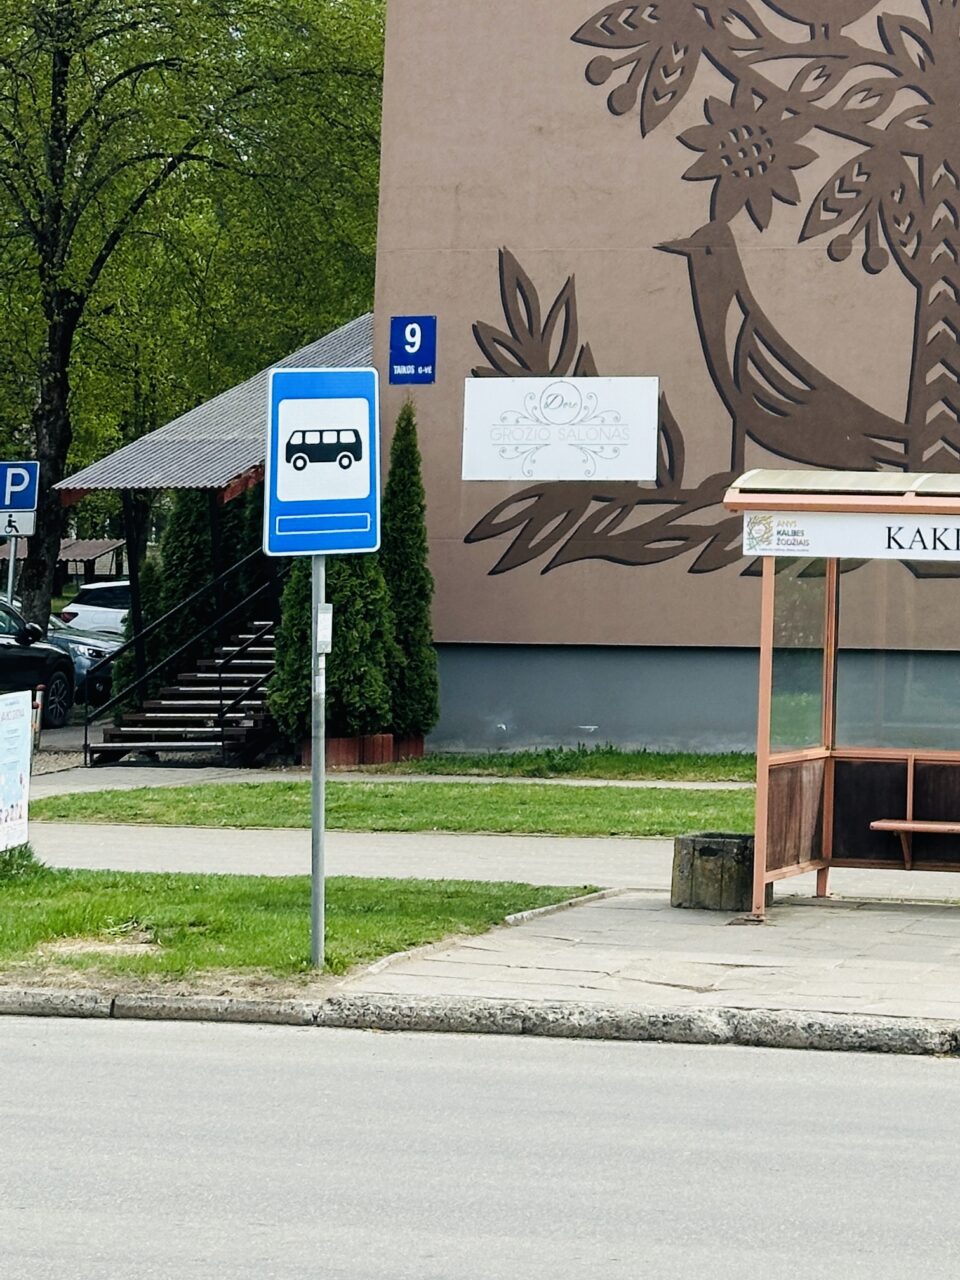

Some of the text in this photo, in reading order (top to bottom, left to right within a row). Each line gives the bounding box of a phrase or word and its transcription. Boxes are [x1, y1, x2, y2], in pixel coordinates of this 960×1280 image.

[404, 322, 422, 354] 9
[558, 427, 630, 441] SALONAS
[4, 467, 30, 506] P
